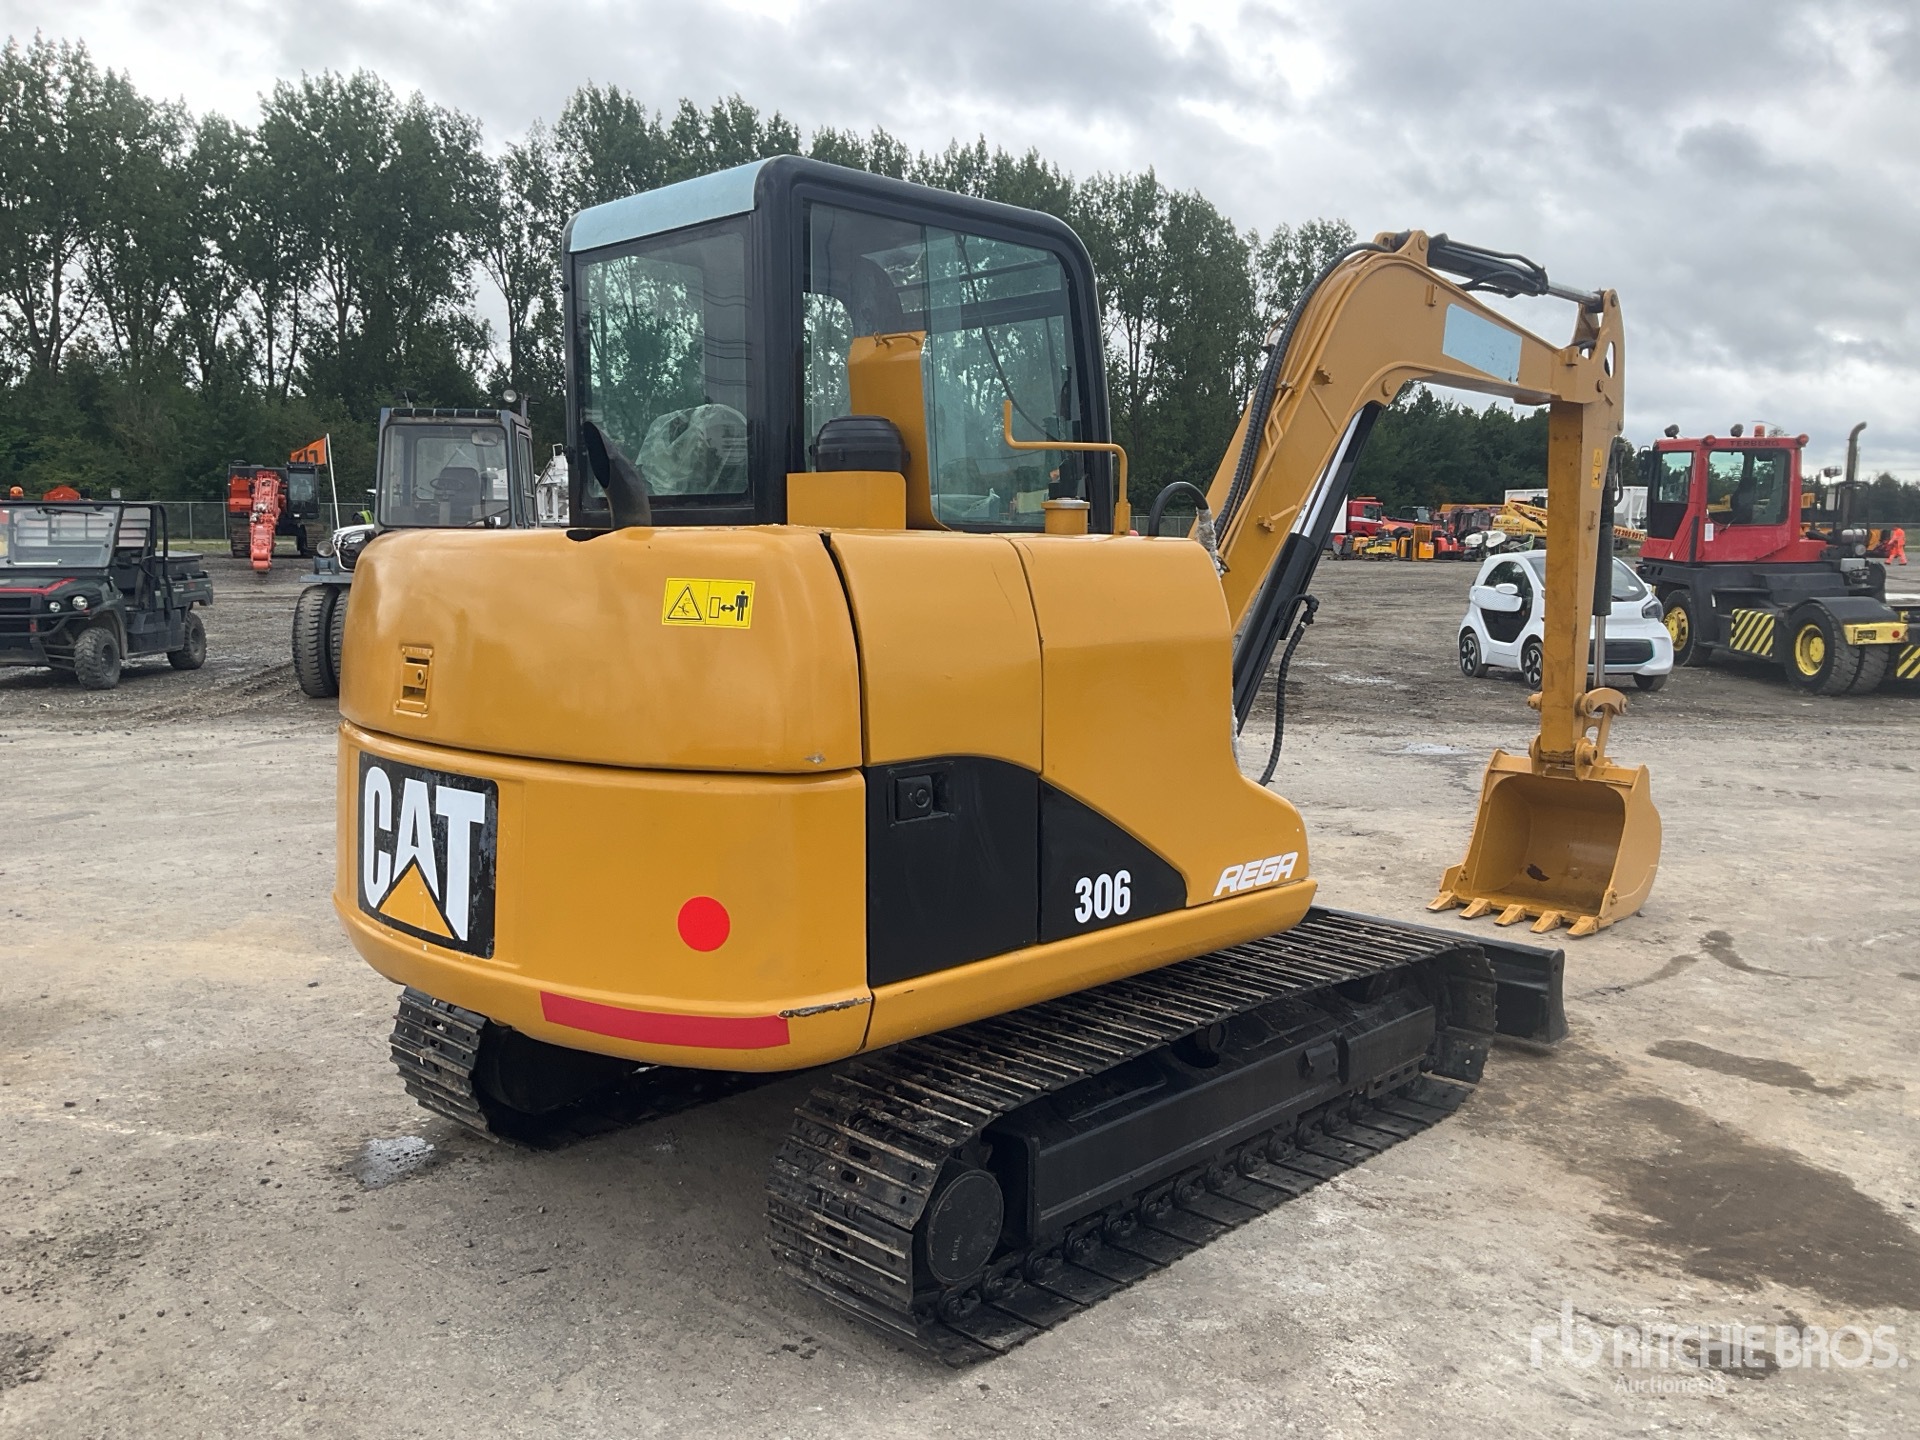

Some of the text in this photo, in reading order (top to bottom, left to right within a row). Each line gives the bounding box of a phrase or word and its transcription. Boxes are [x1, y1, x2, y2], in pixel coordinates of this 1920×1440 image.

[364, 766, 486, 941] CAT
[1213, 851, 1298, 897] REGA
[1074, 869, 1132, 924] 306
